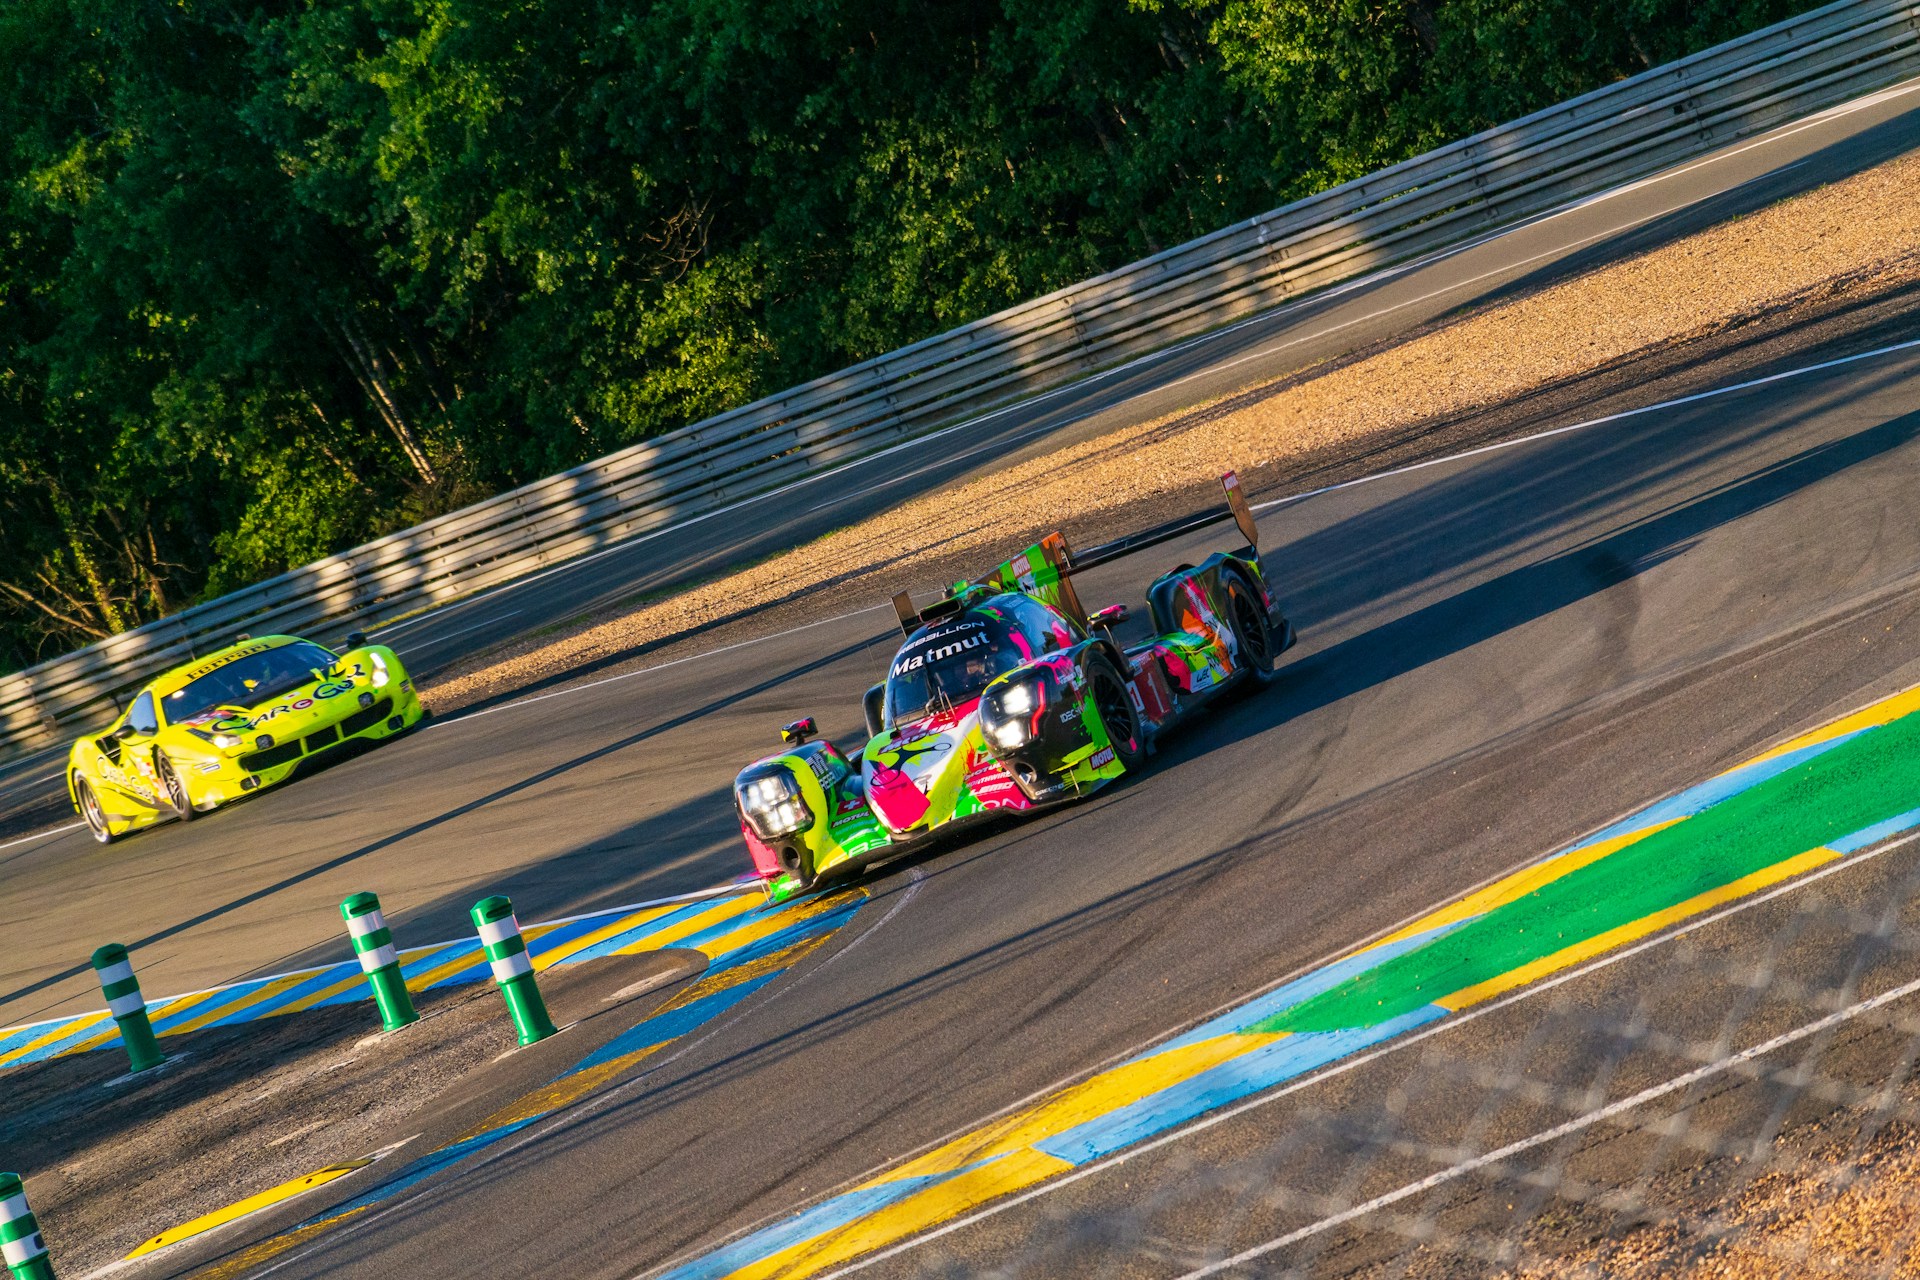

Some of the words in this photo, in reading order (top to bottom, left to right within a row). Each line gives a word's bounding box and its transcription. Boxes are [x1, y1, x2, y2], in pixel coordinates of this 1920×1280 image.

[1011, 555, 1031, 578] MOTUL
[186, 643, 273, 681] Ferrari
[892, 631, 990, 679] Matmut
[1147, 672, 1167, 714] 1
[879, 721, 958, 756] MOTUL
[1091, 747, 1115, 769] MOTUL
[963, 762, 1001, 781] MOTUL
[968, 781, 1016, 797] LEMO
[832, 810, 870, 829] MOTUL
